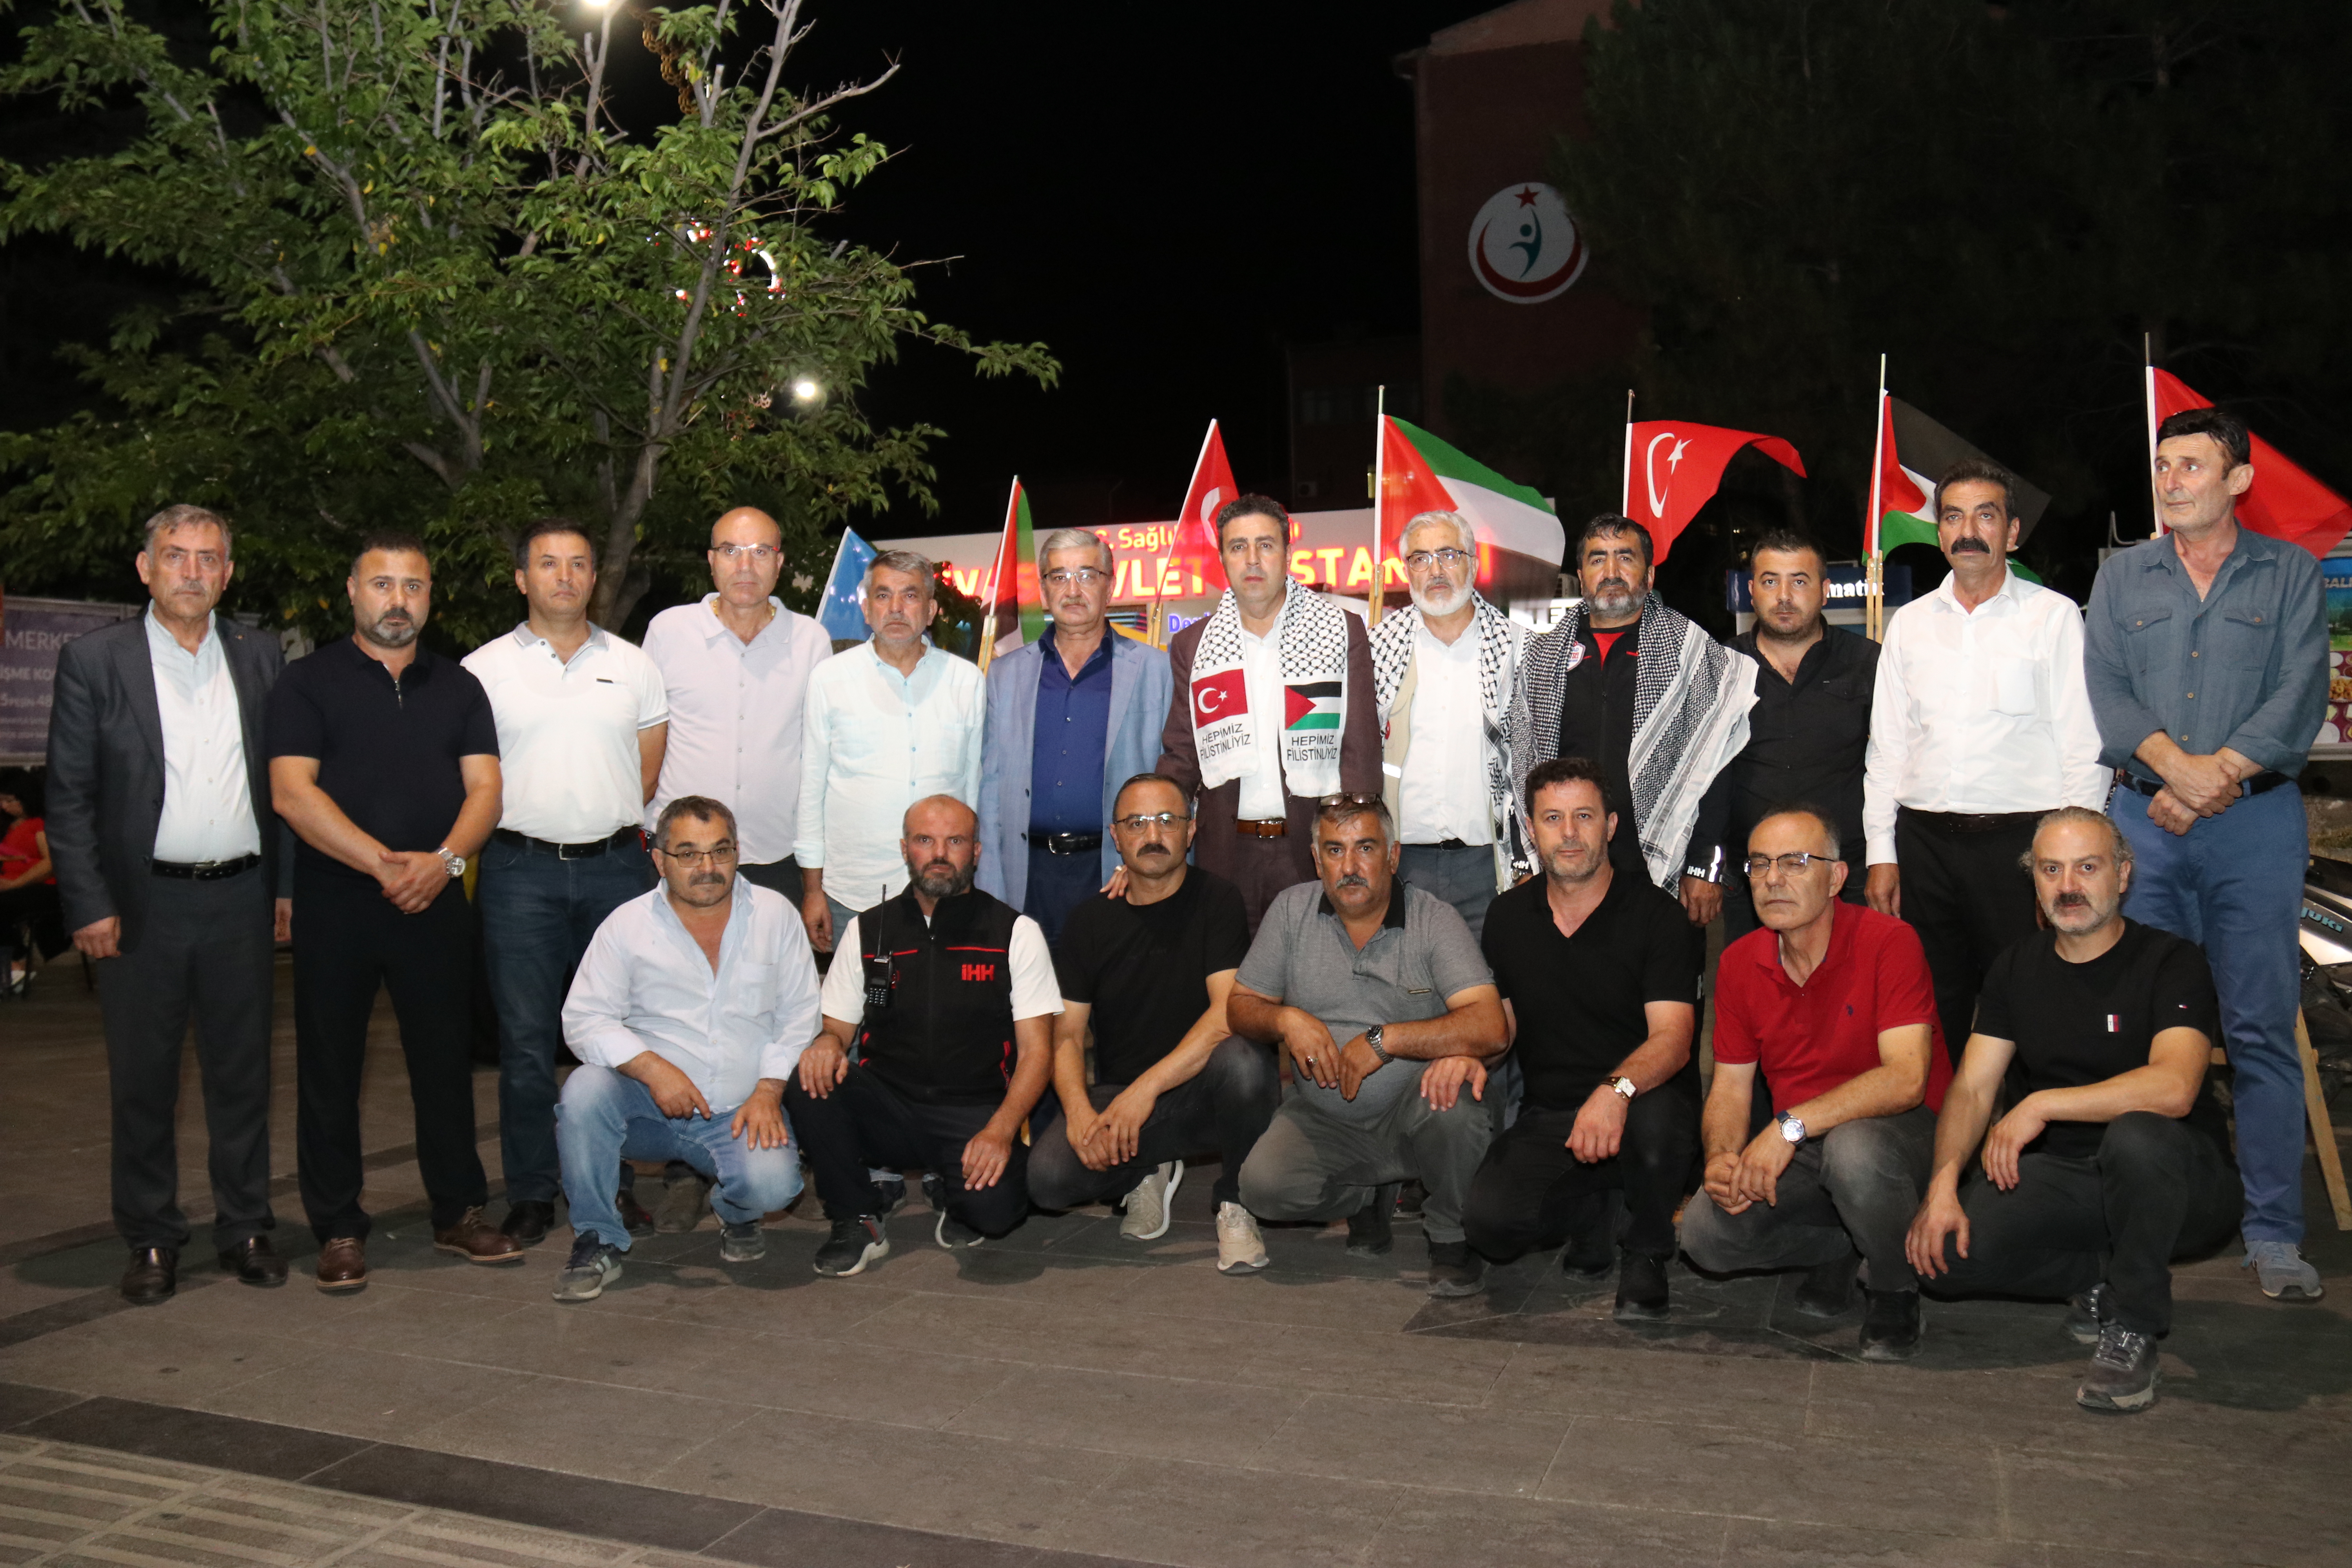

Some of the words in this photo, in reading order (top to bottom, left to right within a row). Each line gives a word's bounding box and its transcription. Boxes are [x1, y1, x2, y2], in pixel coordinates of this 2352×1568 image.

[1202, 723, 1243, 745] HEPİMİZ
[1291, 733, 1334, 746] HEPİMİZ
[1200, 733, 1251, 760] FİLİSTİNLİYİZ
[1287, 746, 1338, 761] FİLİSTİNLİYİZ
